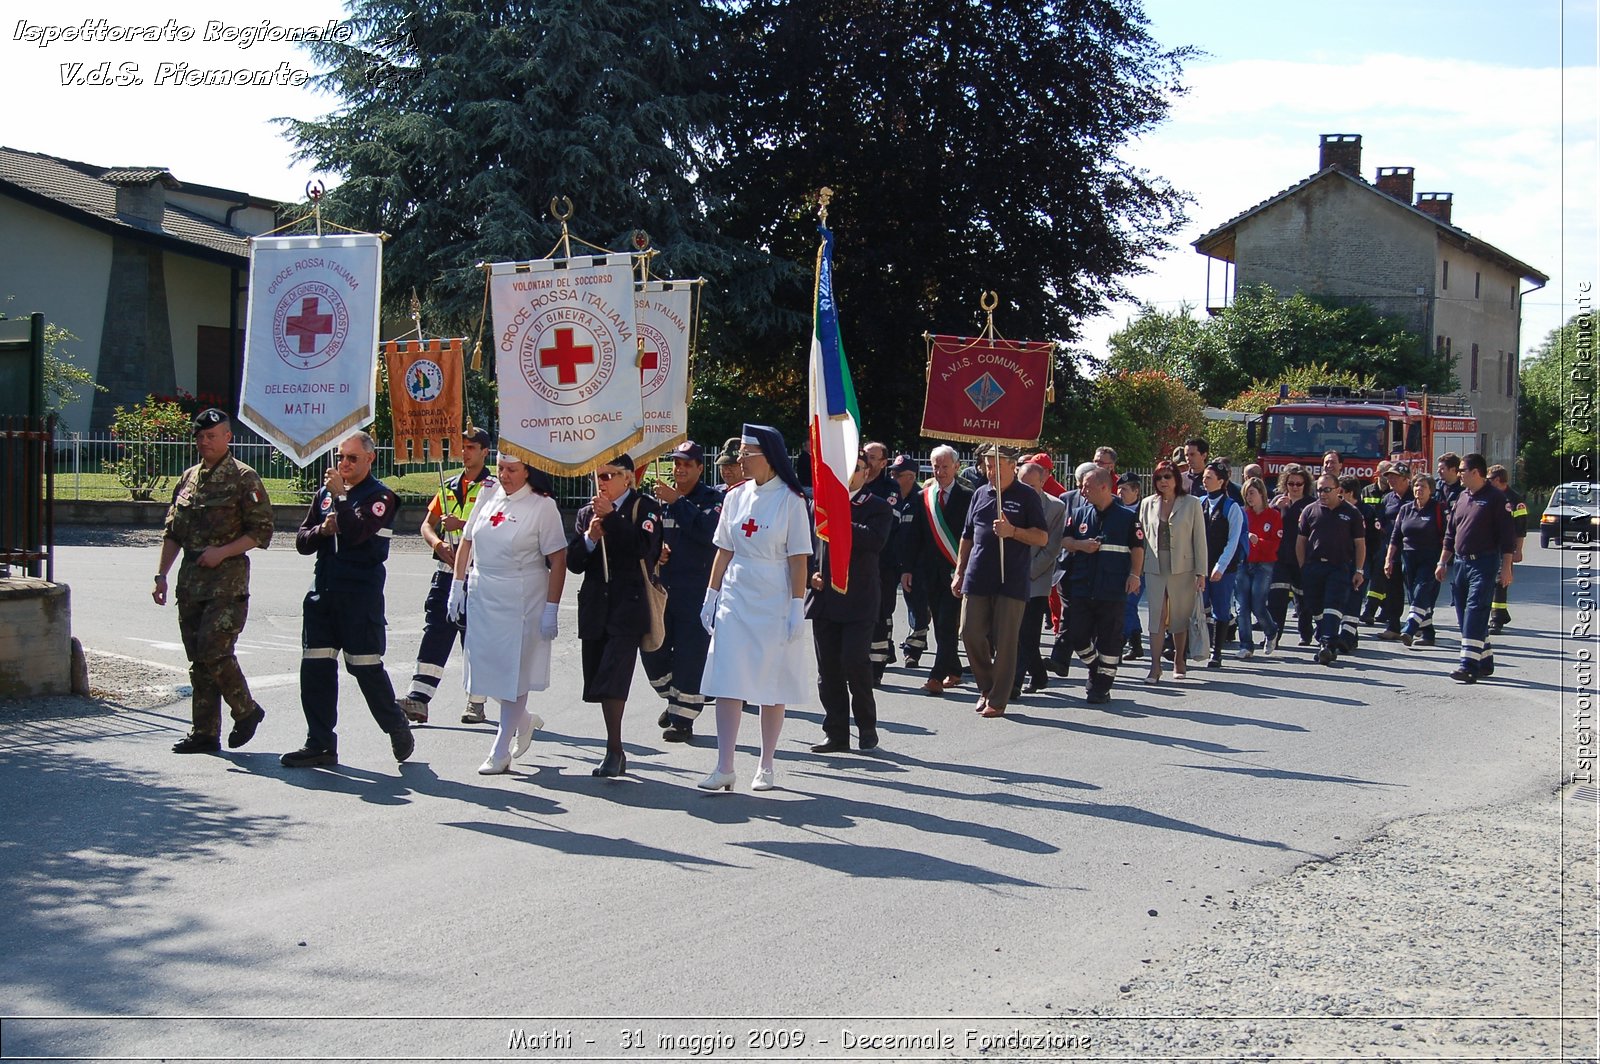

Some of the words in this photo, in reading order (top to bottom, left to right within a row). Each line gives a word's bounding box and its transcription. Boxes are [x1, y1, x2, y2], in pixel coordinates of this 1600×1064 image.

[268, 265, 294, 296] CROCE
[295, 257, 325, 272] ROSSA
[327, 260, 359, 291] ITALIANA
[512, 279, 553, 292] VOLONTARI
[556, 278, 571, 288] DEL
[575, 274, 613, 286] SOCCORSO
[288, 292, 296, 301] DI
[297, 284, 329, 295] GINEVRA
[328, 291, 338, 303] 22
[335, 302, 347, 339] AGOSTO
[500, 307, 532, 352] CROCE
[530, 289, 578, 311] ROSSA
[581, 291, 633, 343] ITALIANA
[546, 309, 593, 326] GINEVRA
[634, 300, 650, 309] SSA
[653, 302, 686, 334] ITALIANA
[274, 298, 290, 358] CONVENZIONE
[534, 321, 545, 333] DI
[593, 325, 607, 338] 22
[325, 340, 340, 357] 1864
[598, 340, 613, 379] AGOSTO
[660, 341, 669, 374] AGOSTO
[522, 335, 559, 401] CONVENZIONE
[941, 357, 973, 382] A.V.I.S.
[977, 354, 1035, 389] COMUNALE
[264, 383, 336, 394] DELEGAZIONE
[339, 383, 350, 393] DI
[578, 379, 602, 399] 1864
[284, 402, 326, 415] MATHI
[644, 410, 672, 419] OCALE
[520, 416, 574, 428] COMITATO
[578, 411, 623, 424] LOCALE
[963, 418, 1000, 429] MATHI
[549, 428, 596, 443] FIANO
[645, 424, 678, 433] RINESE
